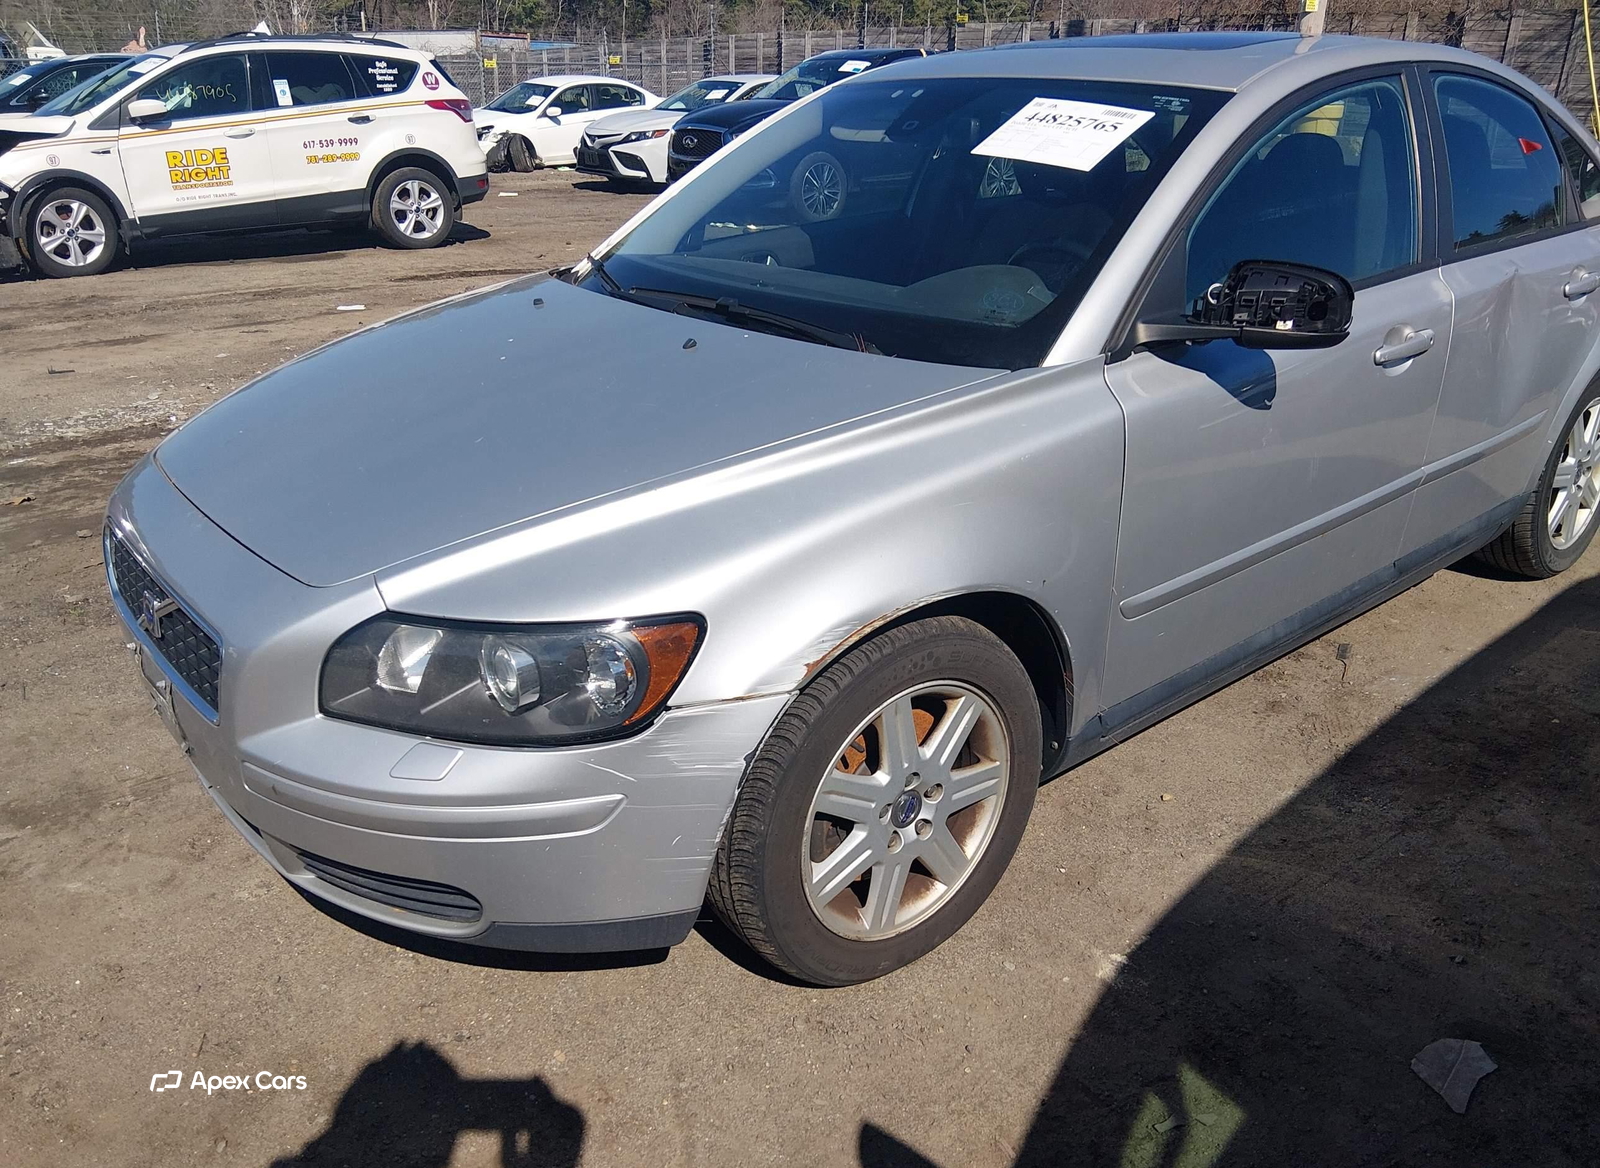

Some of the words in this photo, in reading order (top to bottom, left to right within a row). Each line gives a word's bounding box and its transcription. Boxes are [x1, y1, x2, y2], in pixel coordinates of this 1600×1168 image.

[424, 73, 436, 85] W
[1024, 111, 1123, 133] 44825765
[303, 137, 359, 149] 617-539-9999
[165, 147, 229, 168] RIDE
[306, 152, 360, 164] 781-289-9999
[169, 166, 231, 184] RIGHT
[172, 180, 233, 191] TRANSPORTATION
